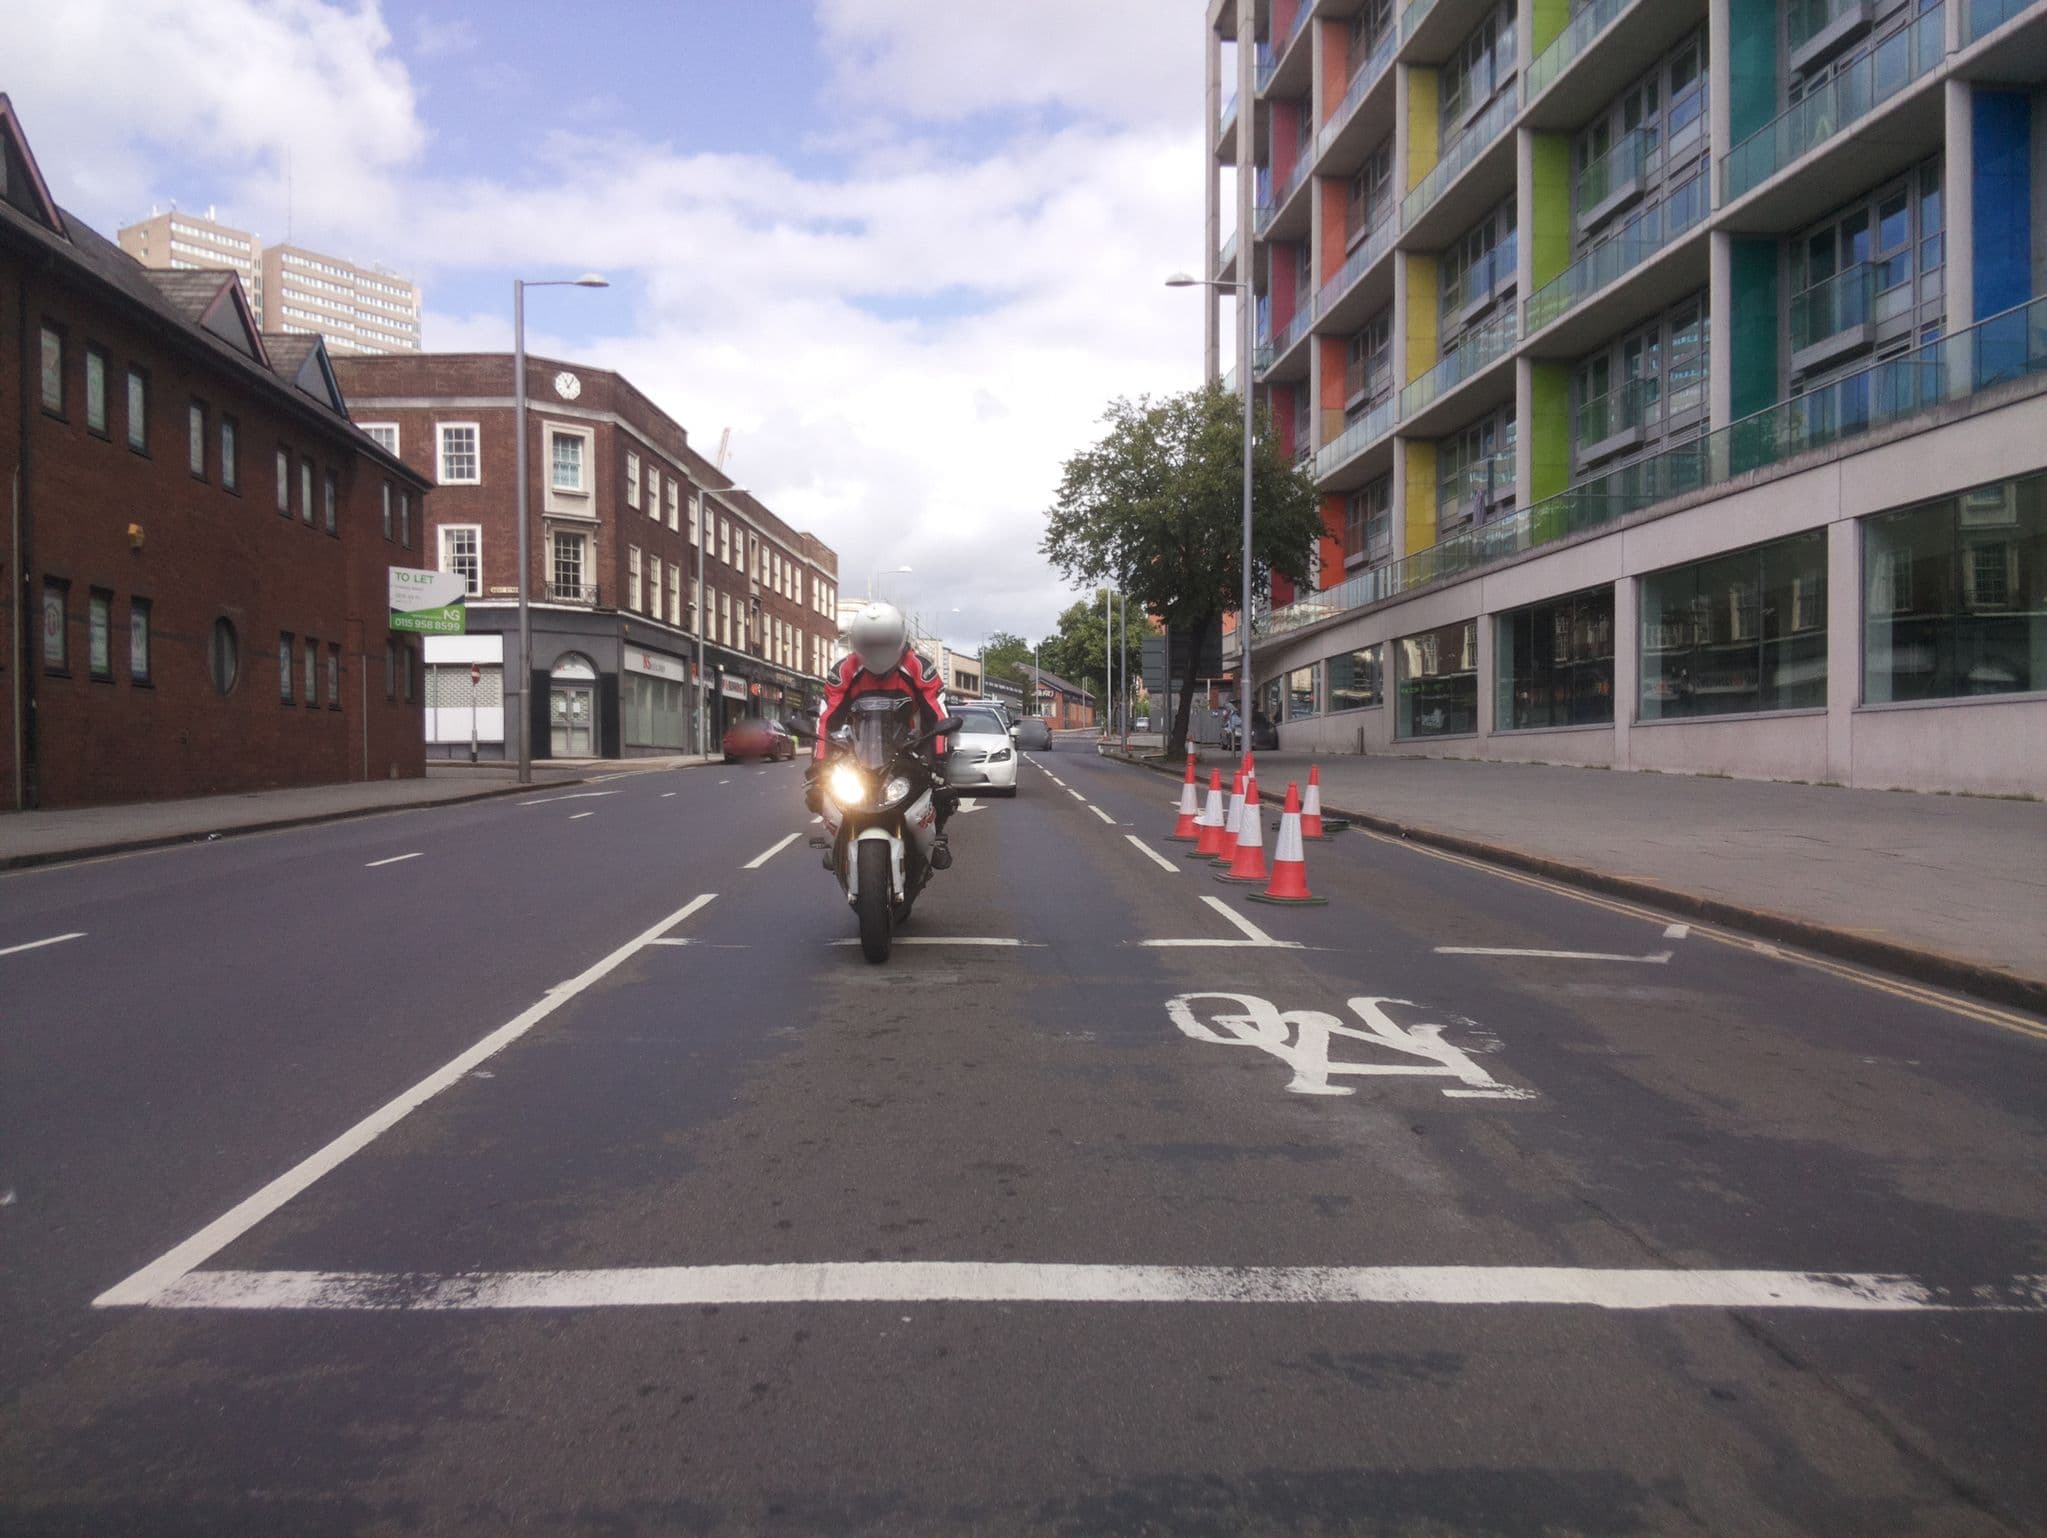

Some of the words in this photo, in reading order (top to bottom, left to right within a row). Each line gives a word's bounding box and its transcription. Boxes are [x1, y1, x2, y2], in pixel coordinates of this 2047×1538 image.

[395, 571, 410, 582] TO
[414, 574, 434, 584] LET
[395, 617, 414, 628] 0115
[415, 619, 433, 630] 958
[434, 621, 460, 631] 8599
